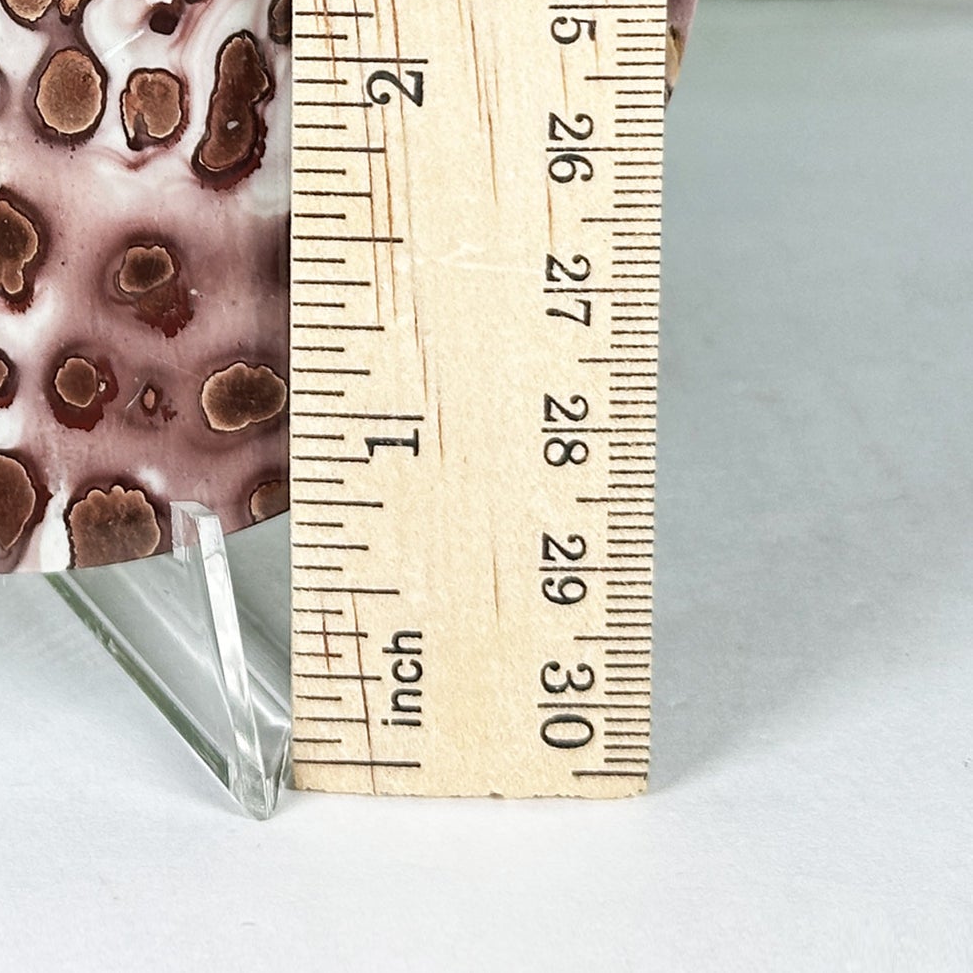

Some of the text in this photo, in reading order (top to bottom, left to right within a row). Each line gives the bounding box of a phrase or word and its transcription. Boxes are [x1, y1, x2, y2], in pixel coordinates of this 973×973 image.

[365, 69, 424, 108] 2
[548, 112, 594, 184] 26
[545, 254, 592, 327] 27
[364, 428, 421, 457] 1
[543, 393, 589, 467] 28
[541, 532, 588, 606] 29
[382, 631, 423, 728] inch
[540, 661, 595, 750] 30
